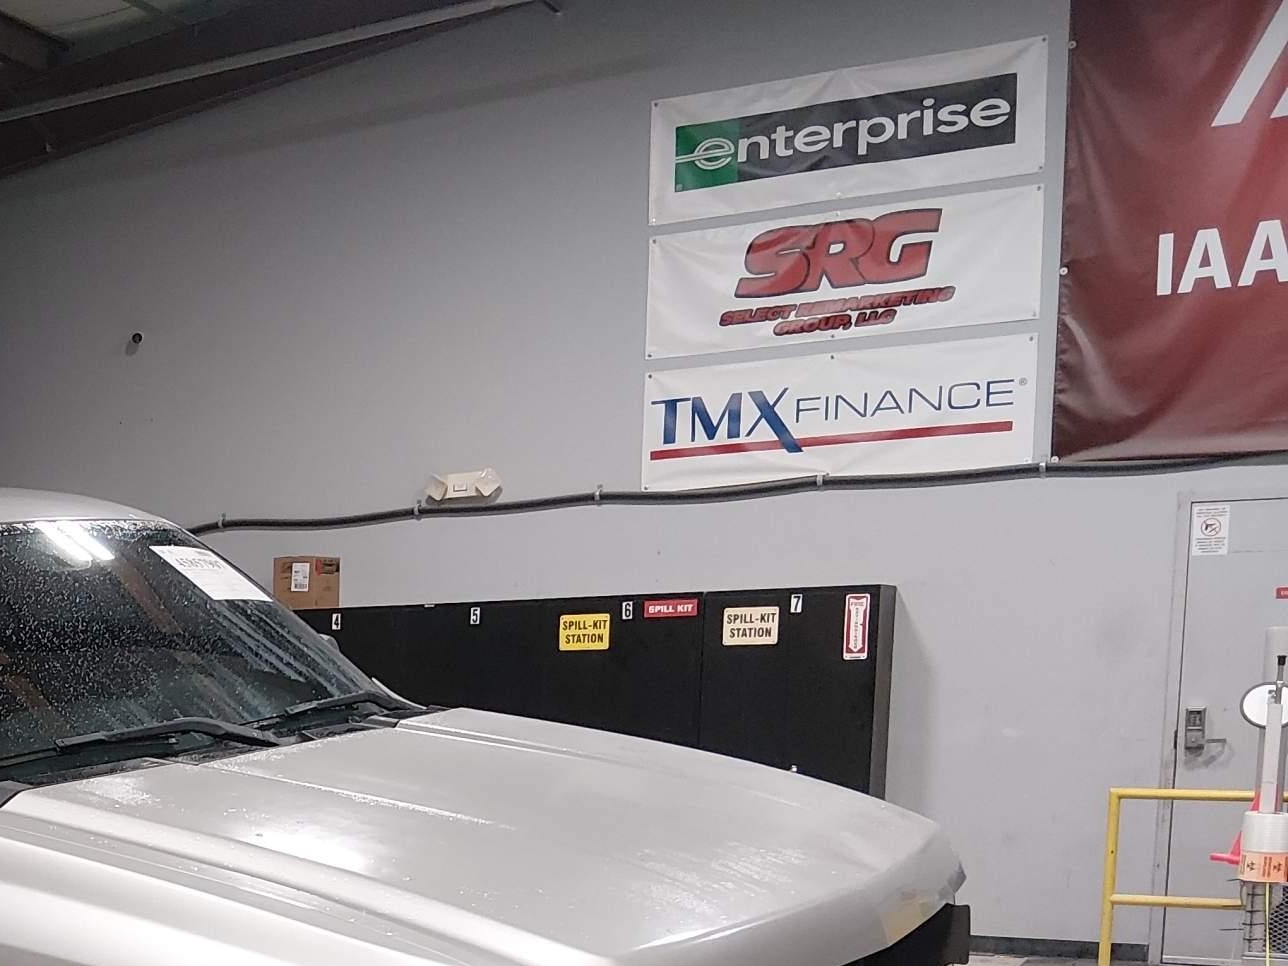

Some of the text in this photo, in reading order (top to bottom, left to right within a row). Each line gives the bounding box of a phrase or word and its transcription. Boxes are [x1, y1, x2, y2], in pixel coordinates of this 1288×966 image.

[675, 97, 1011, 170] enterprise
[734, 208, 943, 299] SRG
[1157, 219, 1288, 296] IAA
[795, 286, 956, 317] MARKETING
[650, 387, 804, 454] TMX
[624, 602, 631, 618] 6
[649, 604, 693, 614] SPILL KIT
[793, 595, 801, 612] 7
[333, 614, 341, 629] 4
[472, 608, 479, 624] 5
[726, 612, 777, 625] SPILL-KIT
[562, 619, 608, 632] SPILL-KIT
[729, 626, 772, 639] STATION
[565, 633, 604, 645] STATION
